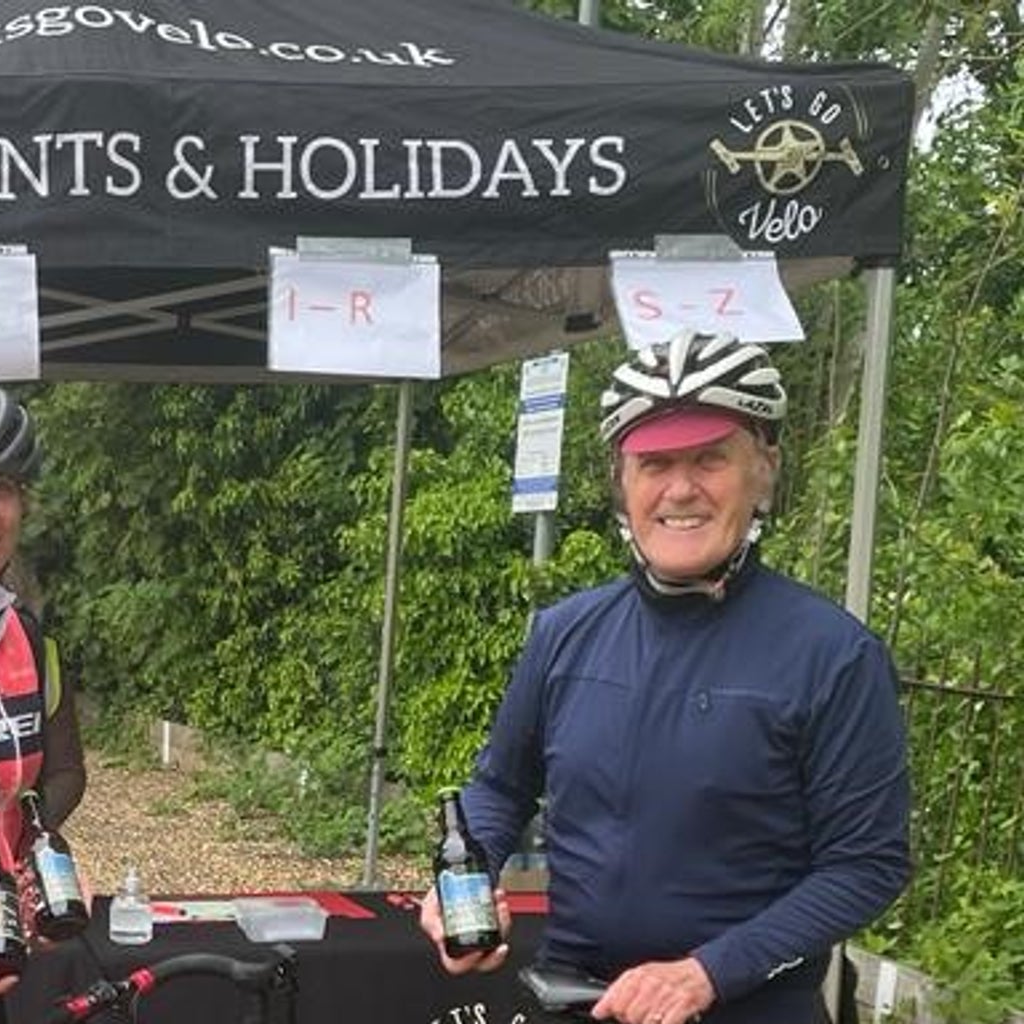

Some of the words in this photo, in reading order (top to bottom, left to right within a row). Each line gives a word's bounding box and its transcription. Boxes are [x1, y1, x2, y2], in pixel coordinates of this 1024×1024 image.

[729, 85, 794, 133] LET'S
[808, 90, 842, 124] GO
[165, 135, 218, 199] &
[236, 136, 627, 200] HOLIDAYS
[738, 199, 823, 243] Velo
